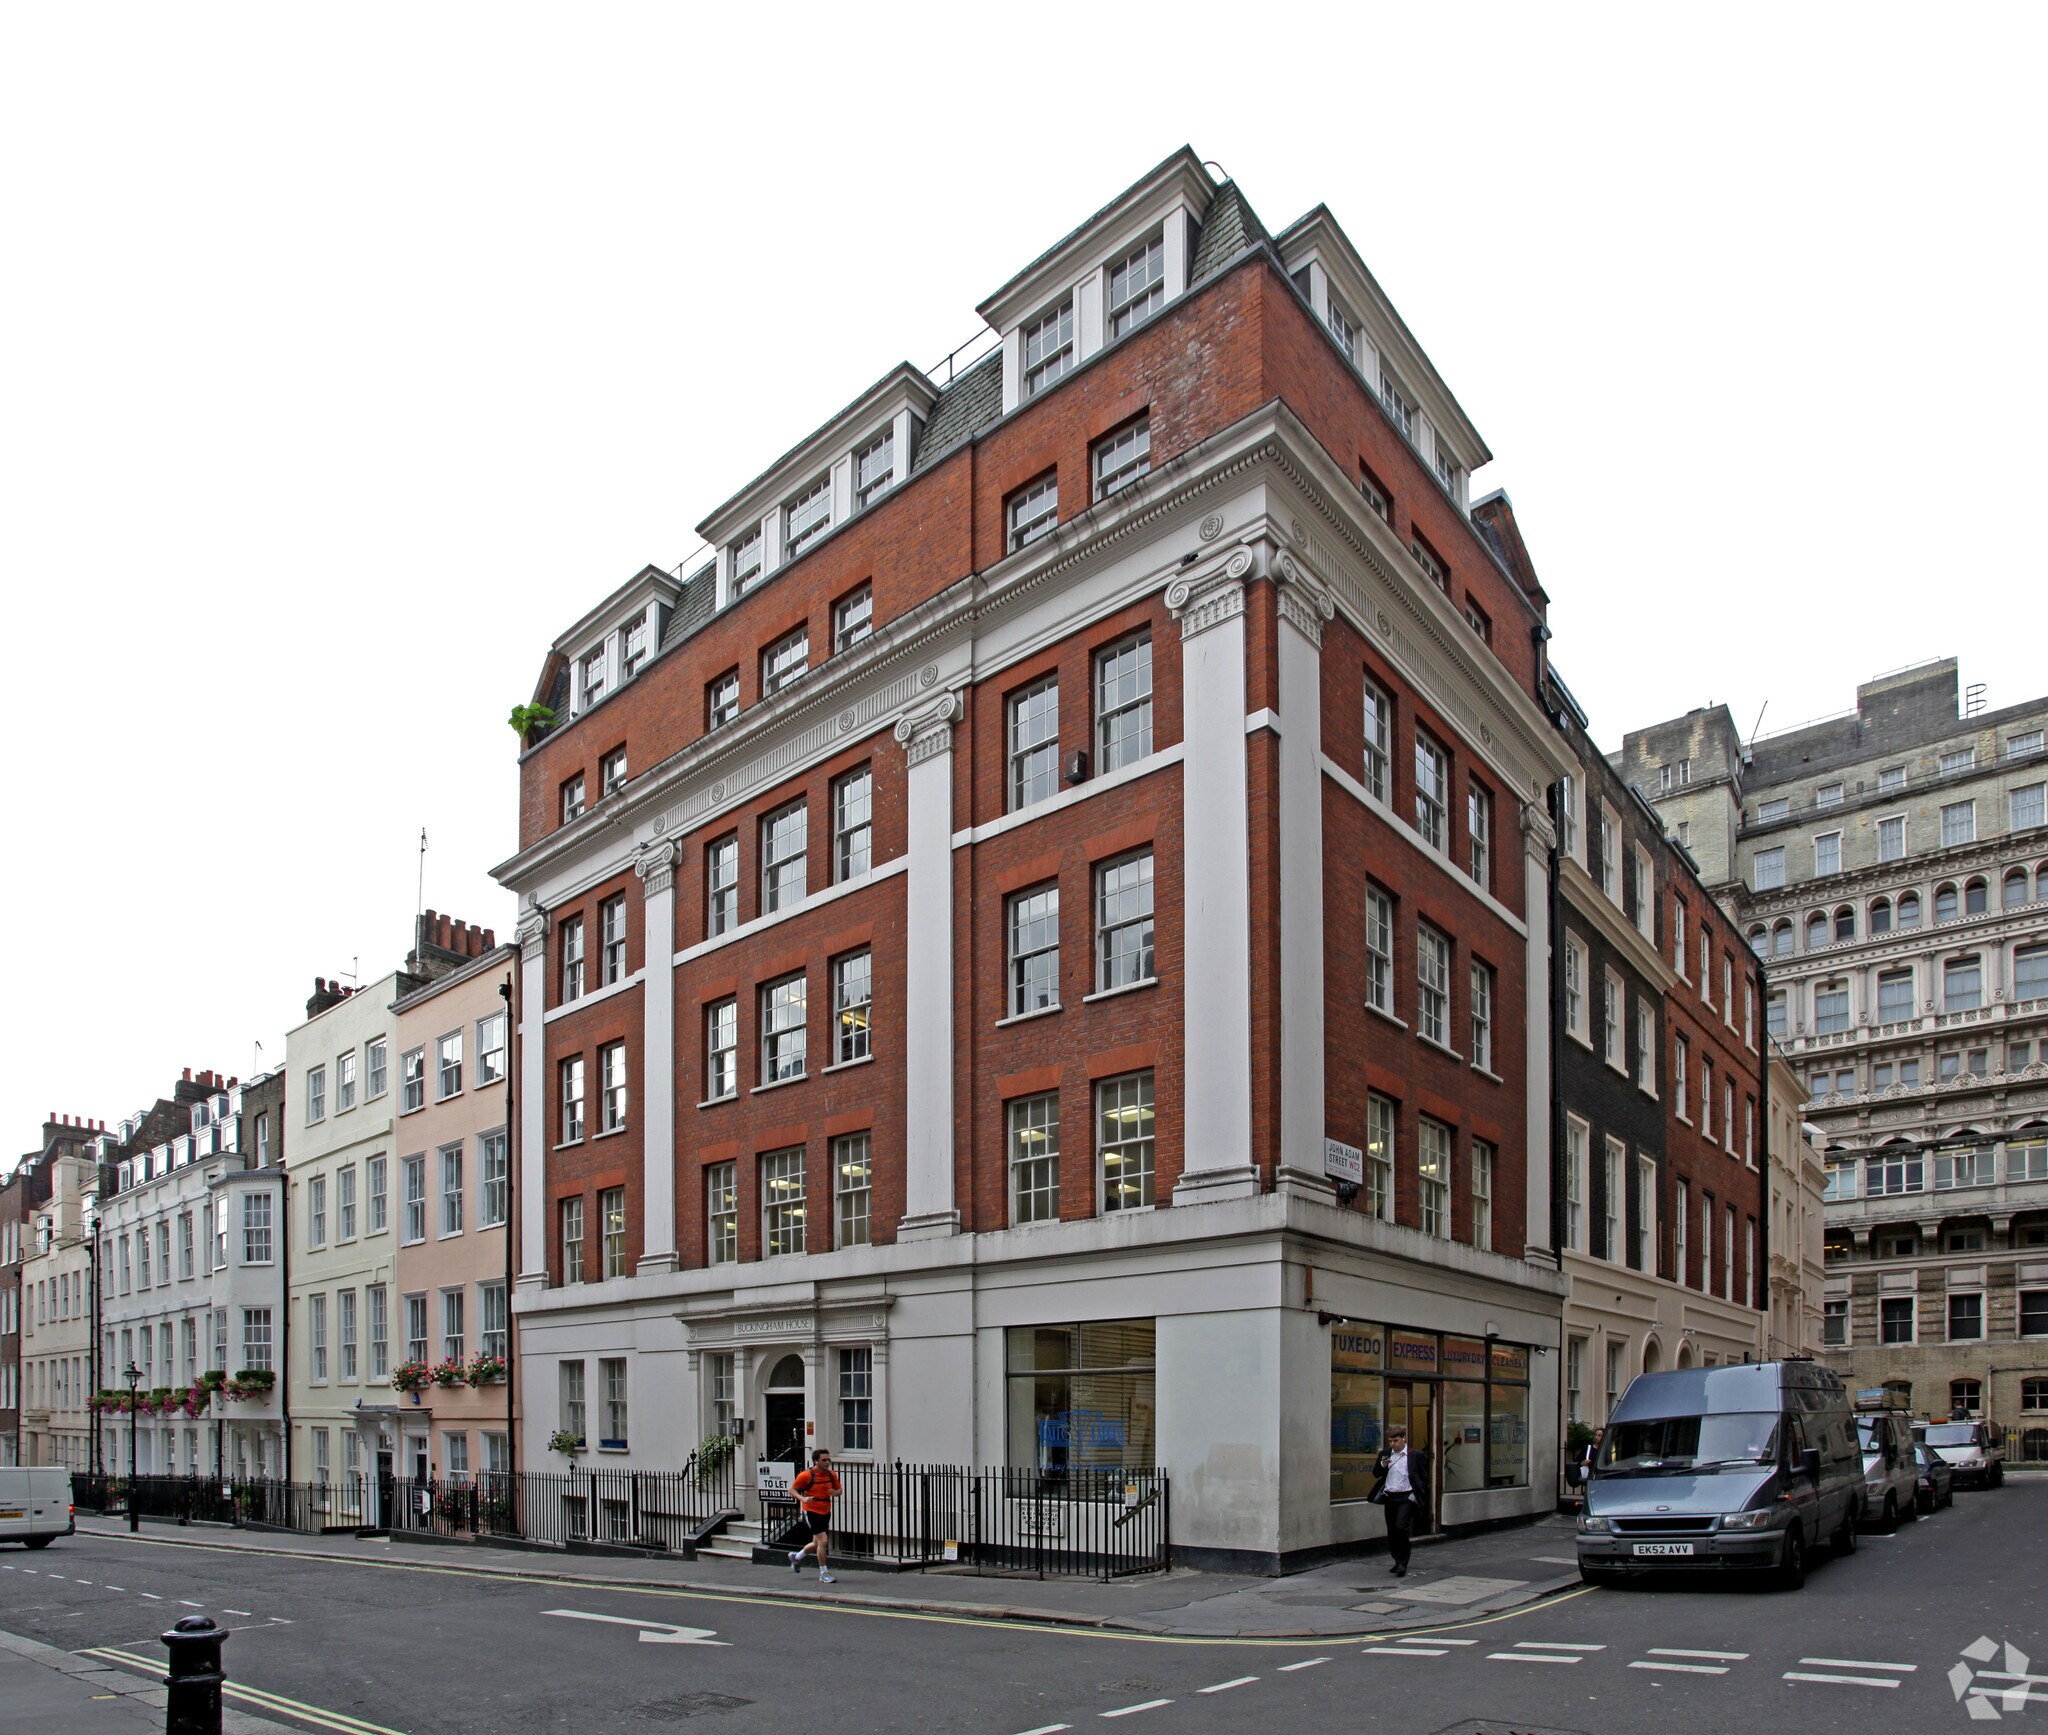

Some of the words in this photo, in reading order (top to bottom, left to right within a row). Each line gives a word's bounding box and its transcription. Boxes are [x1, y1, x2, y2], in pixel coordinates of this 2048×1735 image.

[1328, 1143, 1343, 1155] JOHN
[1344, 1148, 1360, 1161] ADAM
[1328, 1153, 1348, 1167] STREET
[1349, 1160, 1360, 1172] WC2
[737, 1321, 784, 1333] BUCKINGHAM
[786, 1318, 810, 1329] HOUSE
[1331, 1334, 1381, 1355] TUXEDO
[1393, 1342, 1435, 1361] EXPRESS
[1443, 1349, 1471, 1363] LUXURY
[1471, 1352, 1486, 1365] DRY
[1492, 1355, 1527, 1369] CLEANERS
[764, 1480, 773, 1488] TO
[775, 1480, 788, 1488] LET
[1638, 1546, 1665, 1554] EK52
[1668, 1545, 1688, 1554] AVV
